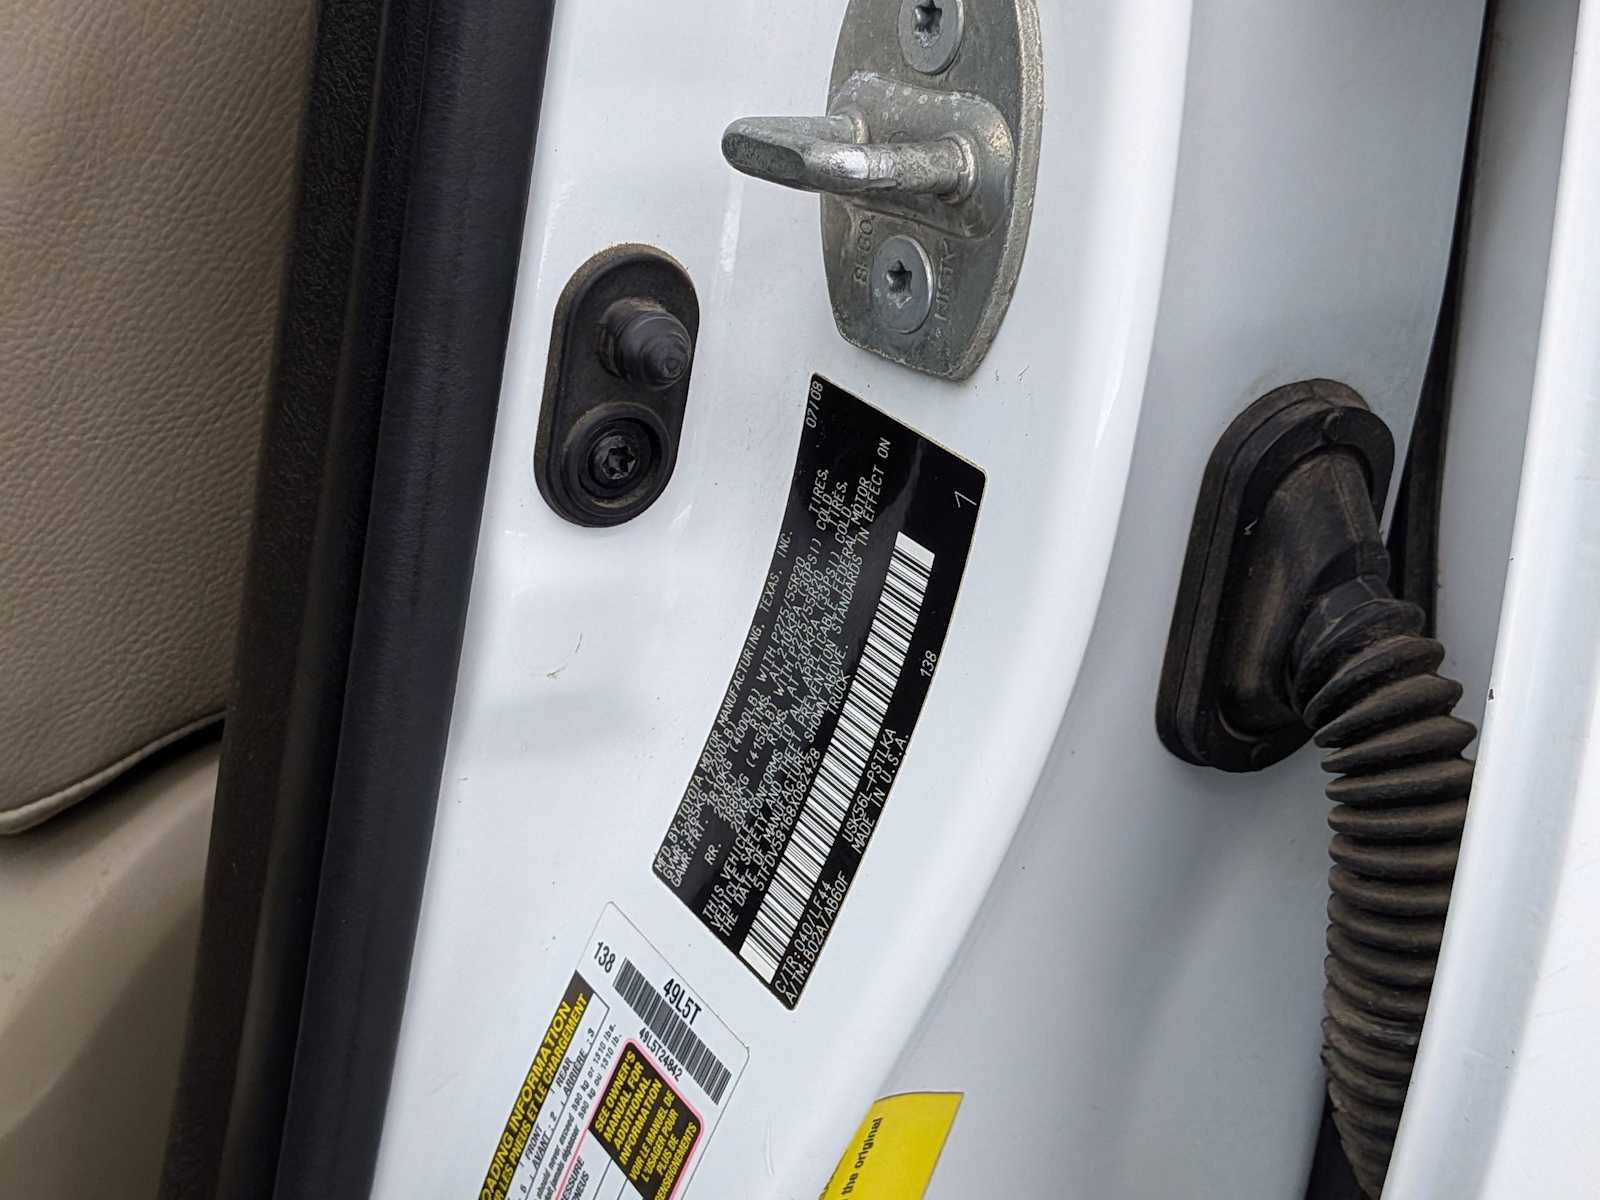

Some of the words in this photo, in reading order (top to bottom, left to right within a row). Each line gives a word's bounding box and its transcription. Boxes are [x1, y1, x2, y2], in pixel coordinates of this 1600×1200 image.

[805, 380, 824, 429] 07/08
[876, 436, 891, 459] ON
[862, 464, 885, 523] EFFECT
[857, 526, 871, 546] IN
[831, 554, 863, 635] STANDARDS
[700, 729, 722, 773] MOTOR
[777, 531, 793, 559] INC.
[706, 757, 733, 807] 1810KG
[729, 688, 762, 752] (4000LB)
[755, 644, 777, 683] WITH
[771, 556, 806, 644] P275/55R20
[808, 468, 829, 515] TIRES,
[920, 650, 937, 679] 138
[702, 884, 724, 920] THIS
[720, 820, 754, 881] VEHICLE
[749, 749, 784, 818] CONFORMS
[778, 722, 793, 743] TO
[789, 696, 805, 722] ALL
[801, 599, 839, 688] APPLICABLE
[831, 534, 859, 596] FEDERAL
[850, 476, 871, 526] MOTOR
[704, 842, 722, 866] RR.
[722, 772, 750, 823] 1880KG
[745, 702, 778, 768] (4150LB)
[773, 659, 795, 698] WITH
[788, 570, 824, 658] P275/55R20
[827, 481, 848, 527] TIRES,
[713, 773, 738, 818] 20X8J
[769, 661, 783, 682] AT
[777, 604, 802, 660] 210KPA
[797, 537, 822, 597] (30PSI)
[730, 788, 755, 833] 20X8J
[786, 674, 800, 698] AT
[795, 618, 821, 674] 230KPA
[815, 550, 841, 610] (33PSI)
[799, 638, 837, 728] PREVENTION
[826, 669, 852, 715] TRUCK
[777, 730, 802, 775] THEFT
[719, 908, 739, 937] THE
[733, 868, 756, 908] DATE
[752, 843, 766, 866] OF
[763, 750, 809, 844] MANUFACTURE
[804, 698, 828, 742] SHOWN
[823, 644, 849, 694] ABOVE.
[766, 780, 784, 812] AND
[851, 812, 876, 854] MADE
[871, 786, 886, 808] IN
[880, 734, 910, 784] U.S.A.
[740, 812, 768, 866] SAFETY
[710, 867, 744, 929] VEHICLE
[593, 941, 616, 973] 138
[663, 978, 702, 1026] 49L5T
[481, 1131, 513, 1200] OADING
[508, 1001, 572, 1133] INFORMATION
[508, 1119, 532, 1166] PNEUS
[527, 1101, 540, 1122] ET
[535, 1083, 548, 1103] LE
[542, 992, 588, 1085] CHARGEMENT
[594, 1106, 611, 1133] SEE
[605, 1050, 636, 1109] OWNER'S
[603, 1090, 632, 1143] MANUAL
[627, 1061, 645, 1091] FOR
[662, 1090, 676, 1108] DE
[524, 1122, 544, 1161] FRONT
[613, 1076, 653, 1150] ADDITIONAL
[619, 1078, 664, 1166] INFORMATION
[645, 1105, 669, 1146] MANUEL
[661, 1108, 680, 1138] POUR
[640, 1142, 651, 1158] LE
[655, 1148, 673, 1176] PLUS
[667, 1134, 680, 1151] DE
[840, 1172, 858, 1195] the
[854, 1117, 883, 1169] original
